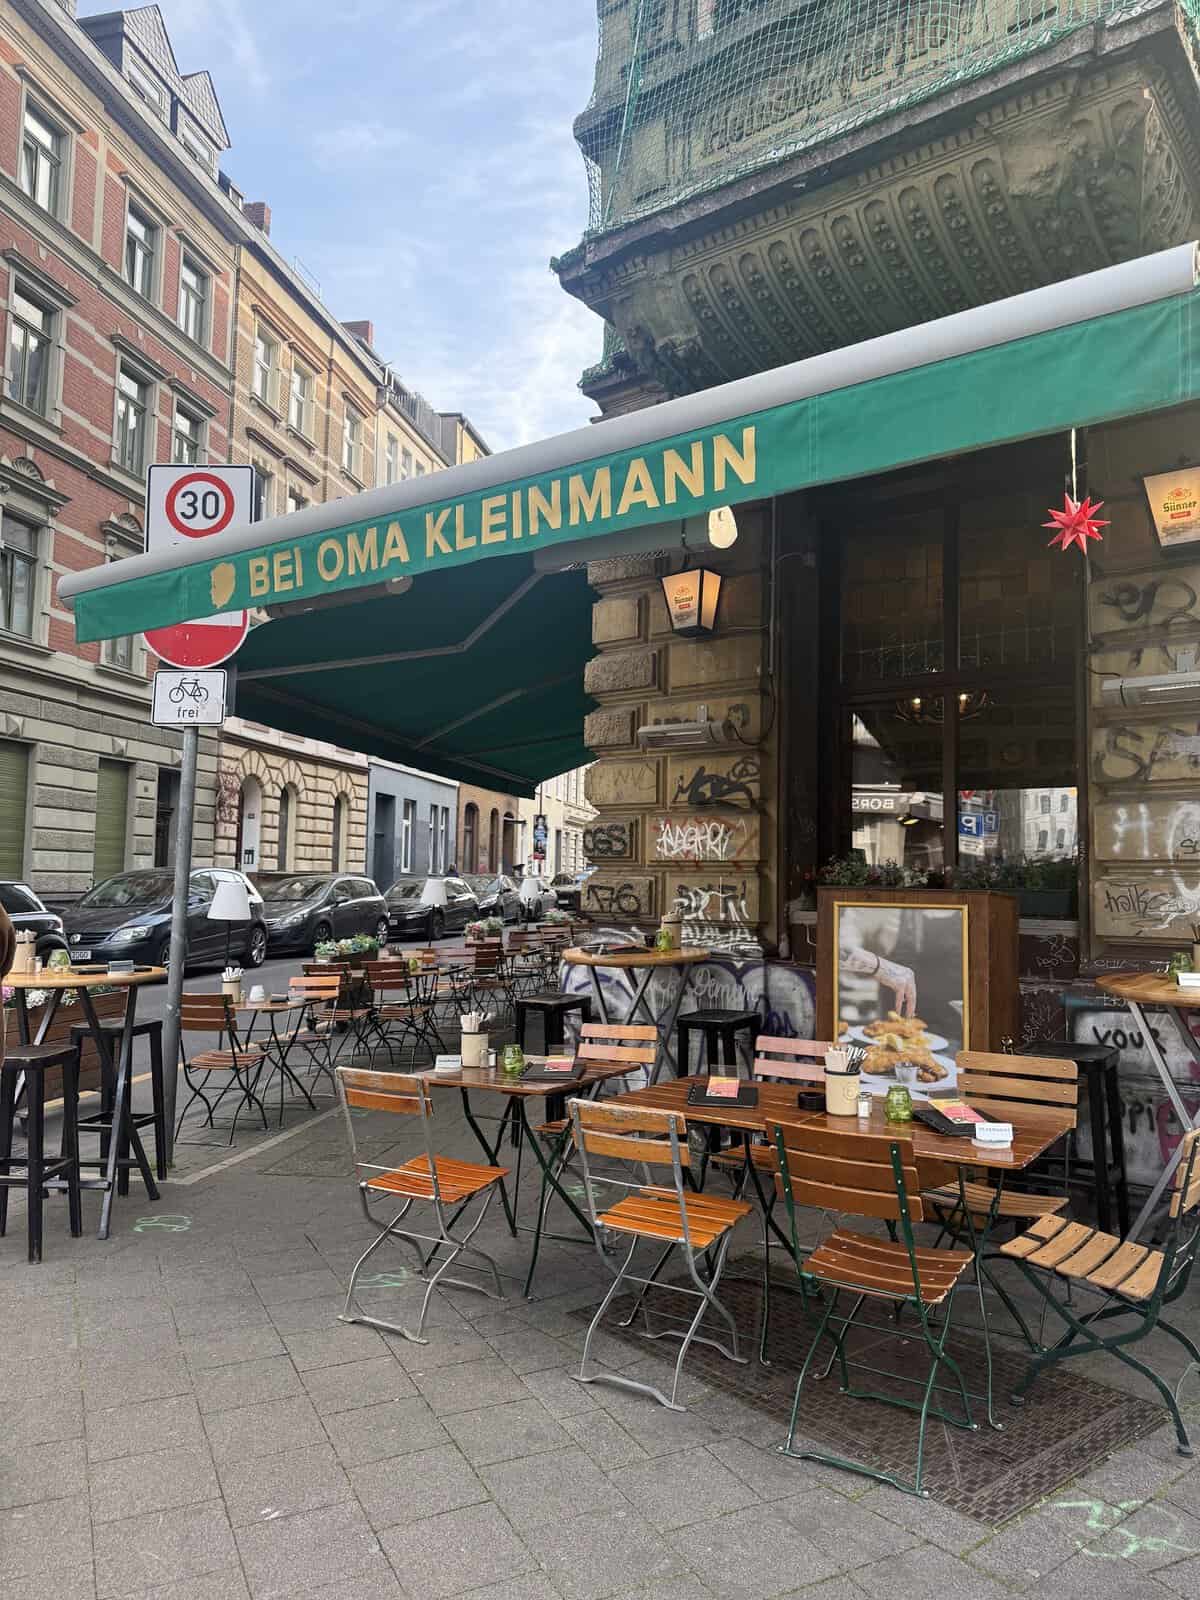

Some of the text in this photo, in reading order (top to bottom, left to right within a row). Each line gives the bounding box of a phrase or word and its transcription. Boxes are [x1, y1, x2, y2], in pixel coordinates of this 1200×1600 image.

[180, 490, 220, 520] 30
[249, 426, 756, 597] BEI OMA KLEINMANN
[1163, 501, 1197, 512] Sünner
[177, 706, 200, 718] frei
